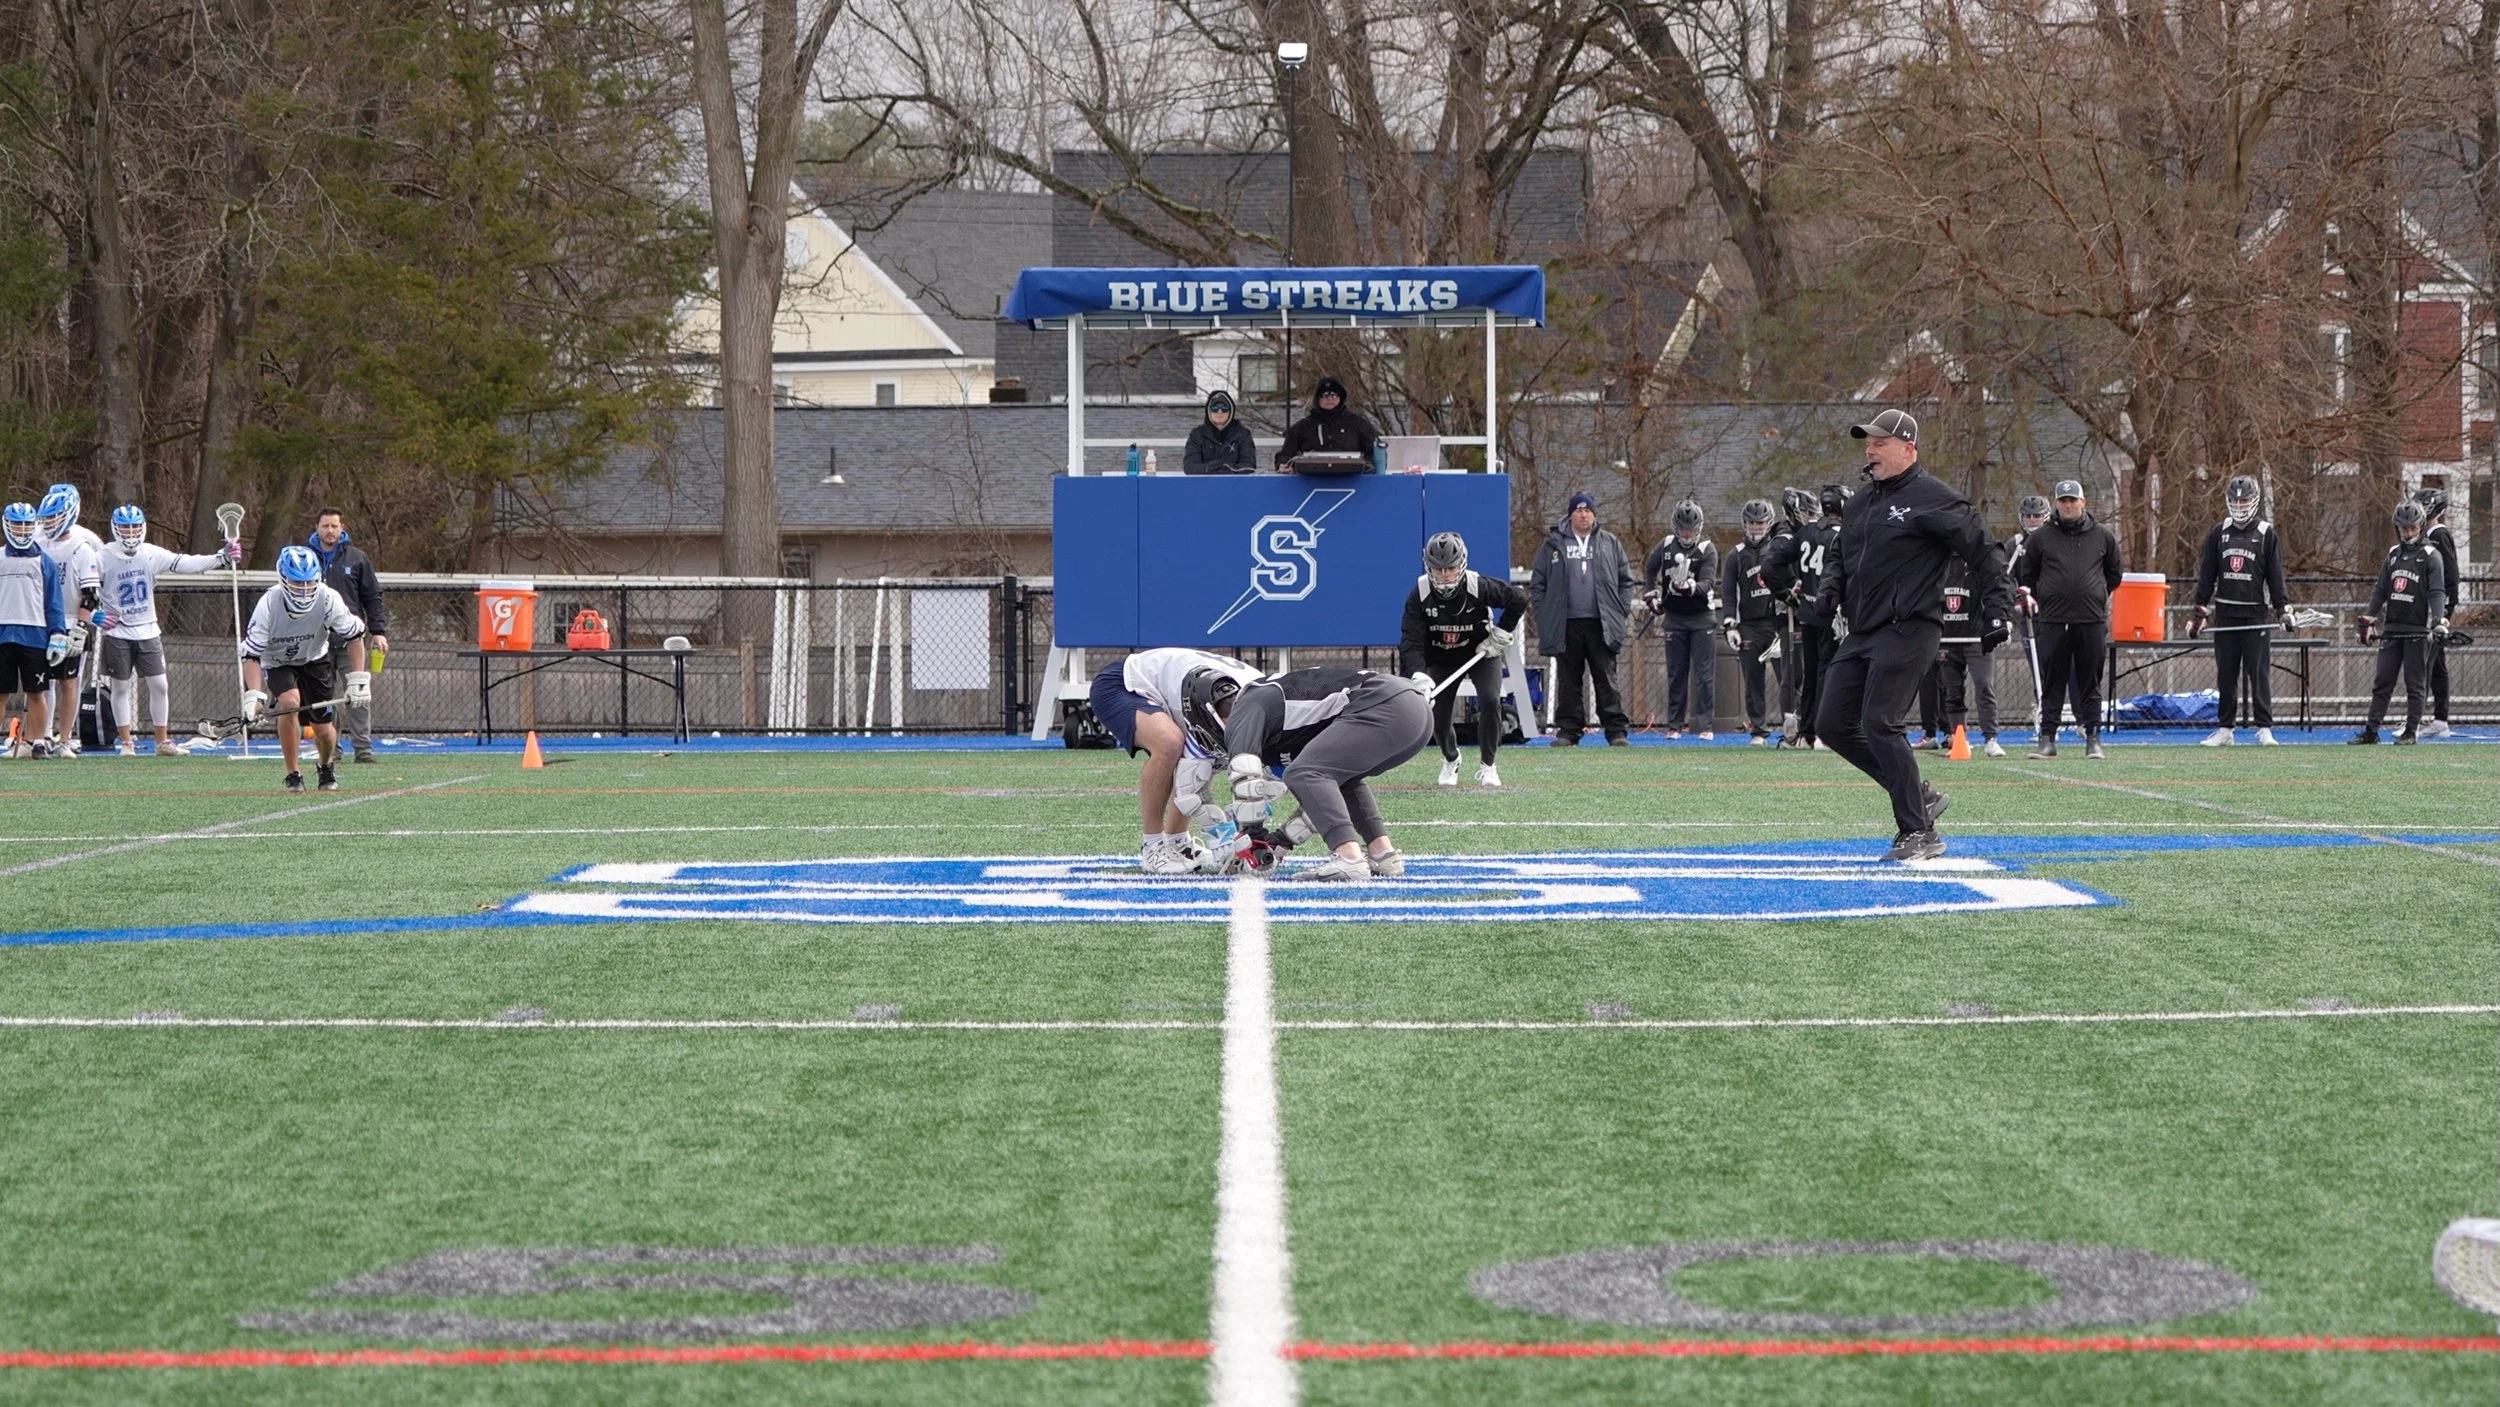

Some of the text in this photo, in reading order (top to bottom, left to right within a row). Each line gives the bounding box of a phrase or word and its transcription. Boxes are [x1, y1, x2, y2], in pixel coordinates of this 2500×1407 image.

[1108, 279, 1459, 313] BLUE STREAKS
[1251, 515, 1317, 600] S
[1800, 541, 1825, 575] 24
[118, 579, 149, 607] 20
[495, 599, 512, 618] G
